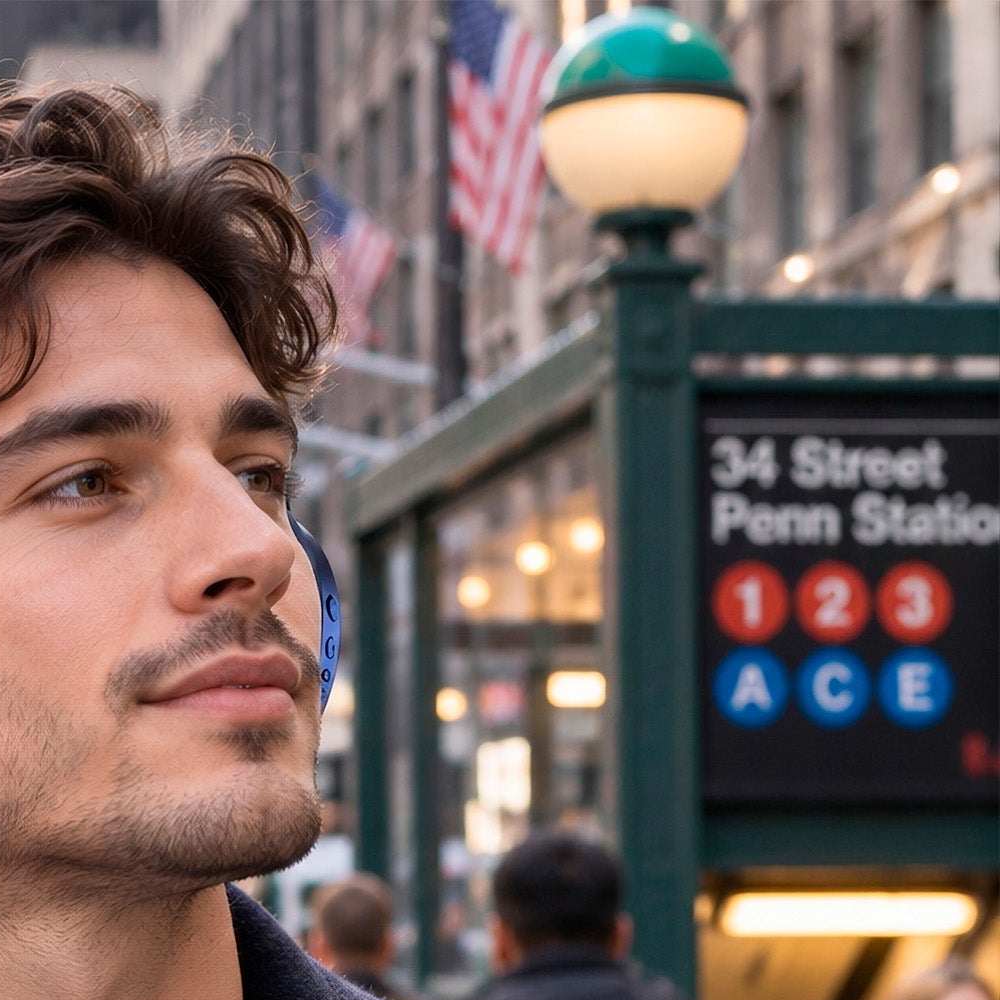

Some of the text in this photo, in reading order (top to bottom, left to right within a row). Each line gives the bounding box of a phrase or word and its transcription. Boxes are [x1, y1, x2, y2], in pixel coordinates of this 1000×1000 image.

[711, 436, 948, 490] 34 Street
[711, 490, 1000, 547] Penn Statio
[734, 576, 934, 629] 1 2 3
[731, 661, 933, 713] A C E
